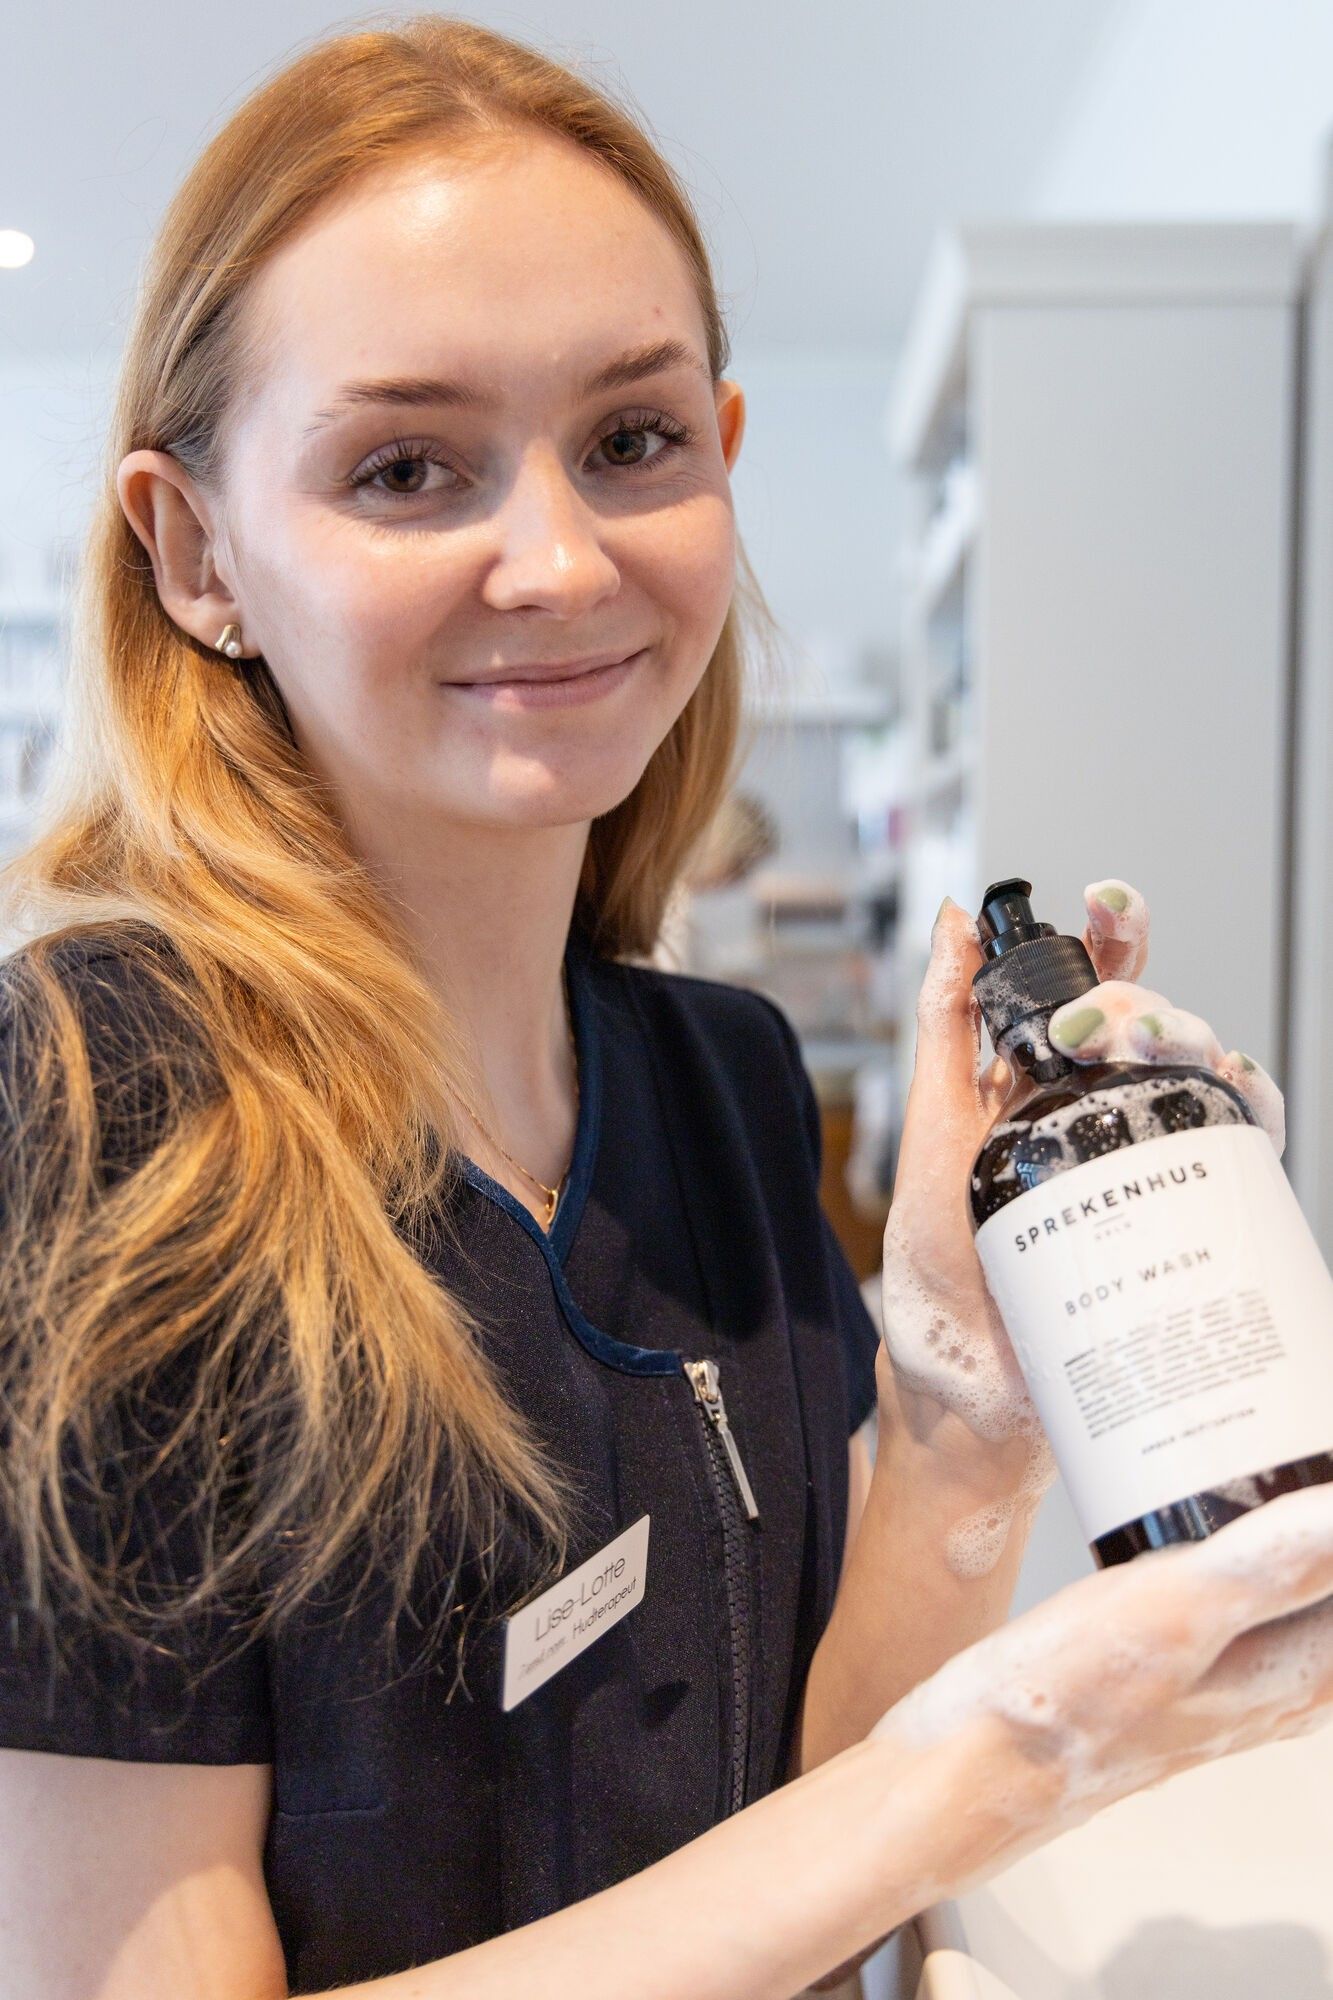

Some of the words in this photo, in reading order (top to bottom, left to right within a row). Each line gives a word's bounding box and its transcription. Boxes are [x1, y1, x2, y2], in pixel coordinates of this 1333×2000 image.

[1014, 1162, 1208, 1252] SPREKENHUS
[1064, 1277, 1124, 1316] BODY
[1140, 1248, 1211, 1282] WASH
[534, 1556, 626, 1641] Lise-Lotte
[573, 1576, 637, 1639] Hudterapeut
